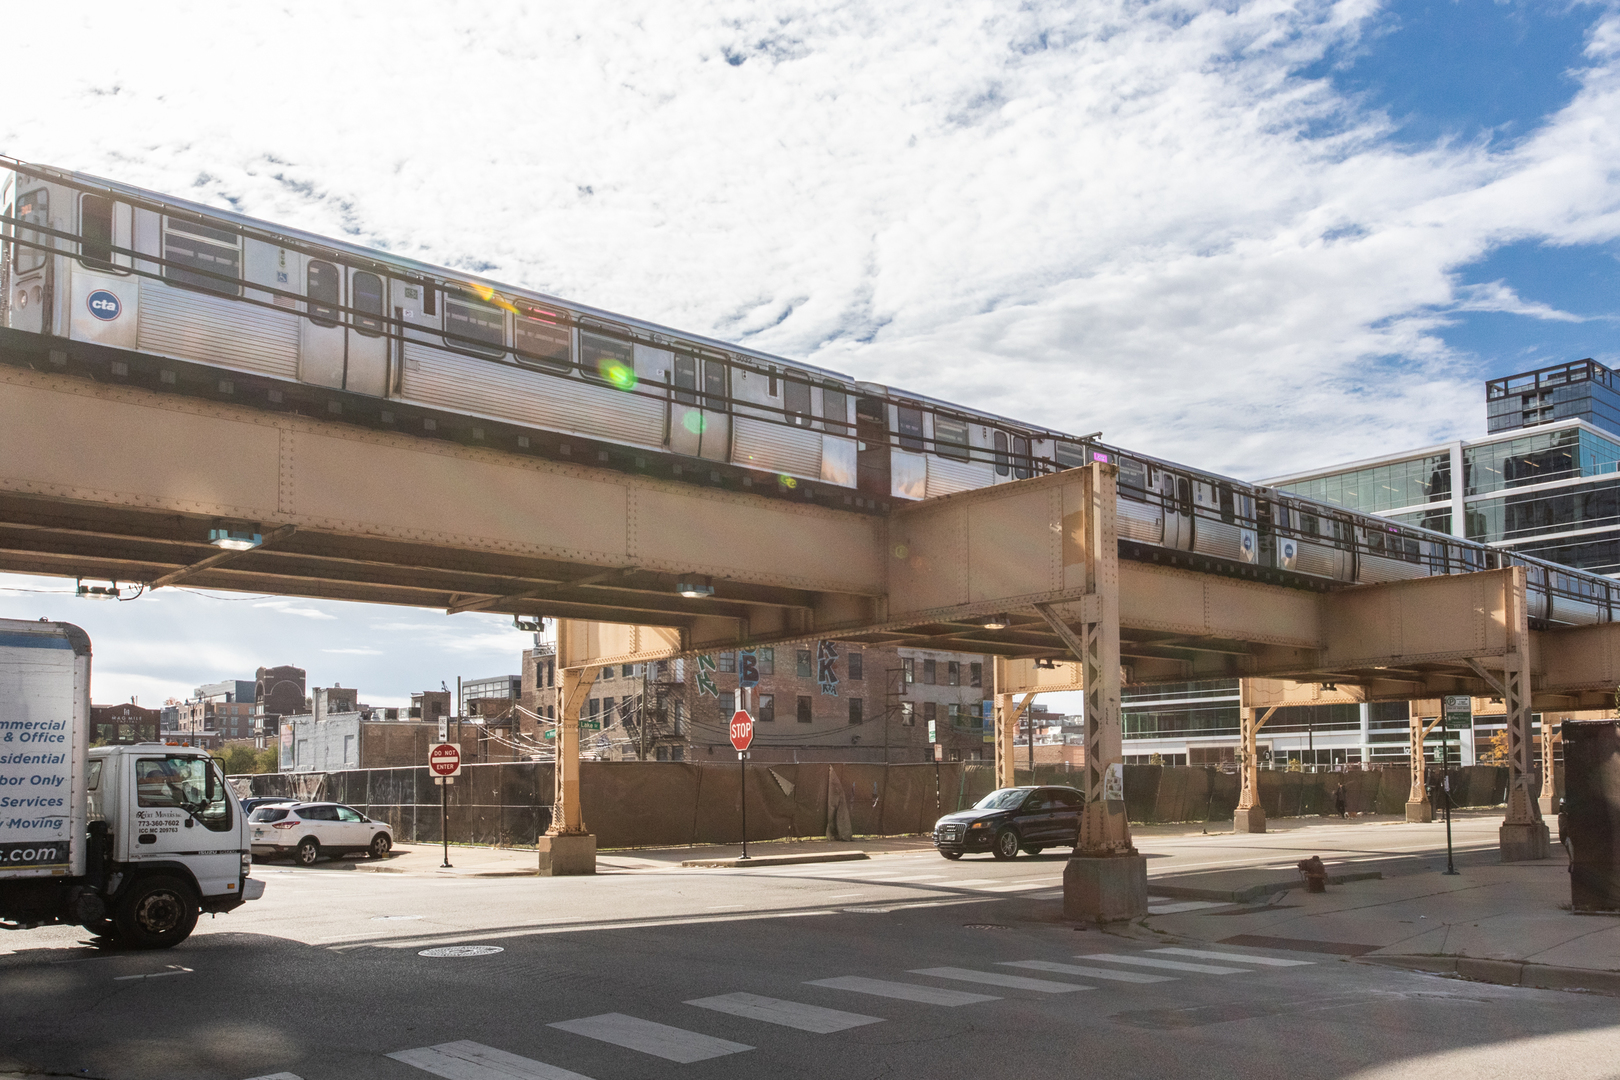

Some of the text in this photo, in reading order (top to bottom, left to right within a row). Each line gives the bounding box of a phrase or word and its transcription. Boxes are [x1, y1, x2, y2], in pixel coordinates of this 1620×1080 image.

[92, 299, 116, 311] cta
[0, 720, 66, 730] mmercial
[731, 722, 751, 739] STOP
[4, 732, 65, 743] & Office
[0, 753, 65, 764] sidential
[0, 775, 64, 787] bor Only
[0, 796, 63, 807] Services
[8, 817, 63, 830] Moving
